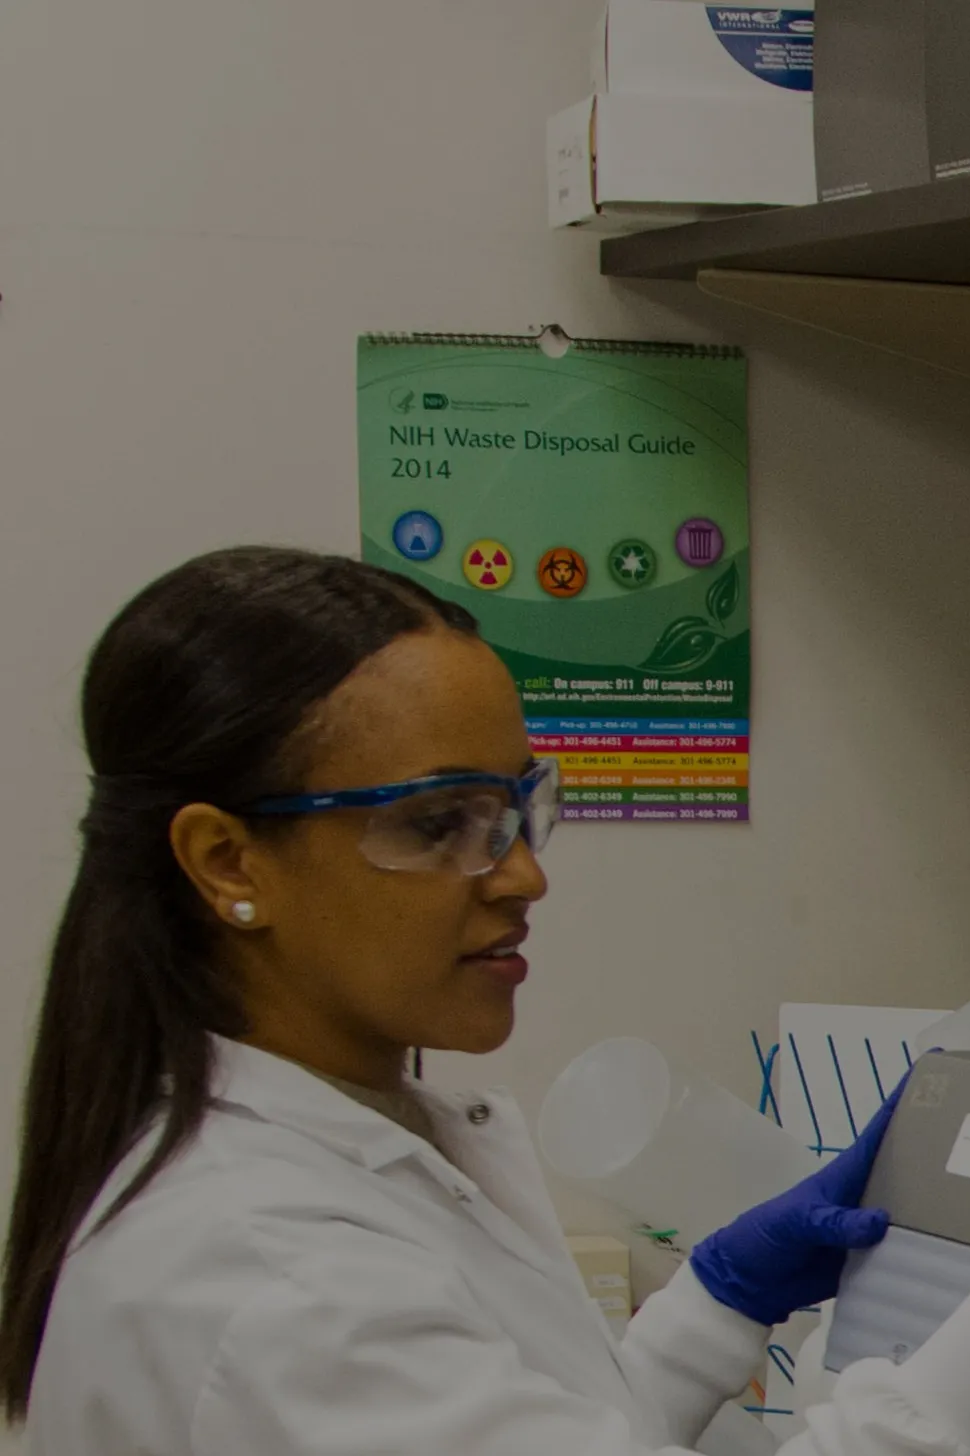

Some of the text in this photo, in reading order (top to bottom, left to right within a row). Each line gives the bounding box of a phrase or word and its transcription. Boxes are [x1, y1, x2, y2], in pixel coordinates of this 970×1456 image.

[717, 11, 750, 21] VWR
[390, 426, 695, 456] NIH Waste Disposal Guide
[391, 458, 452, 479] 2014
[525, 676, 733, 692] call: On campus: 911 Off campus: 9-911
[632, 737, 677, 746] Assistance:
[633, 757, 676, 765] Assistance:
[632, 792, 677, 801] Assistance:
[632, 809, 677, 818] Assistance:
